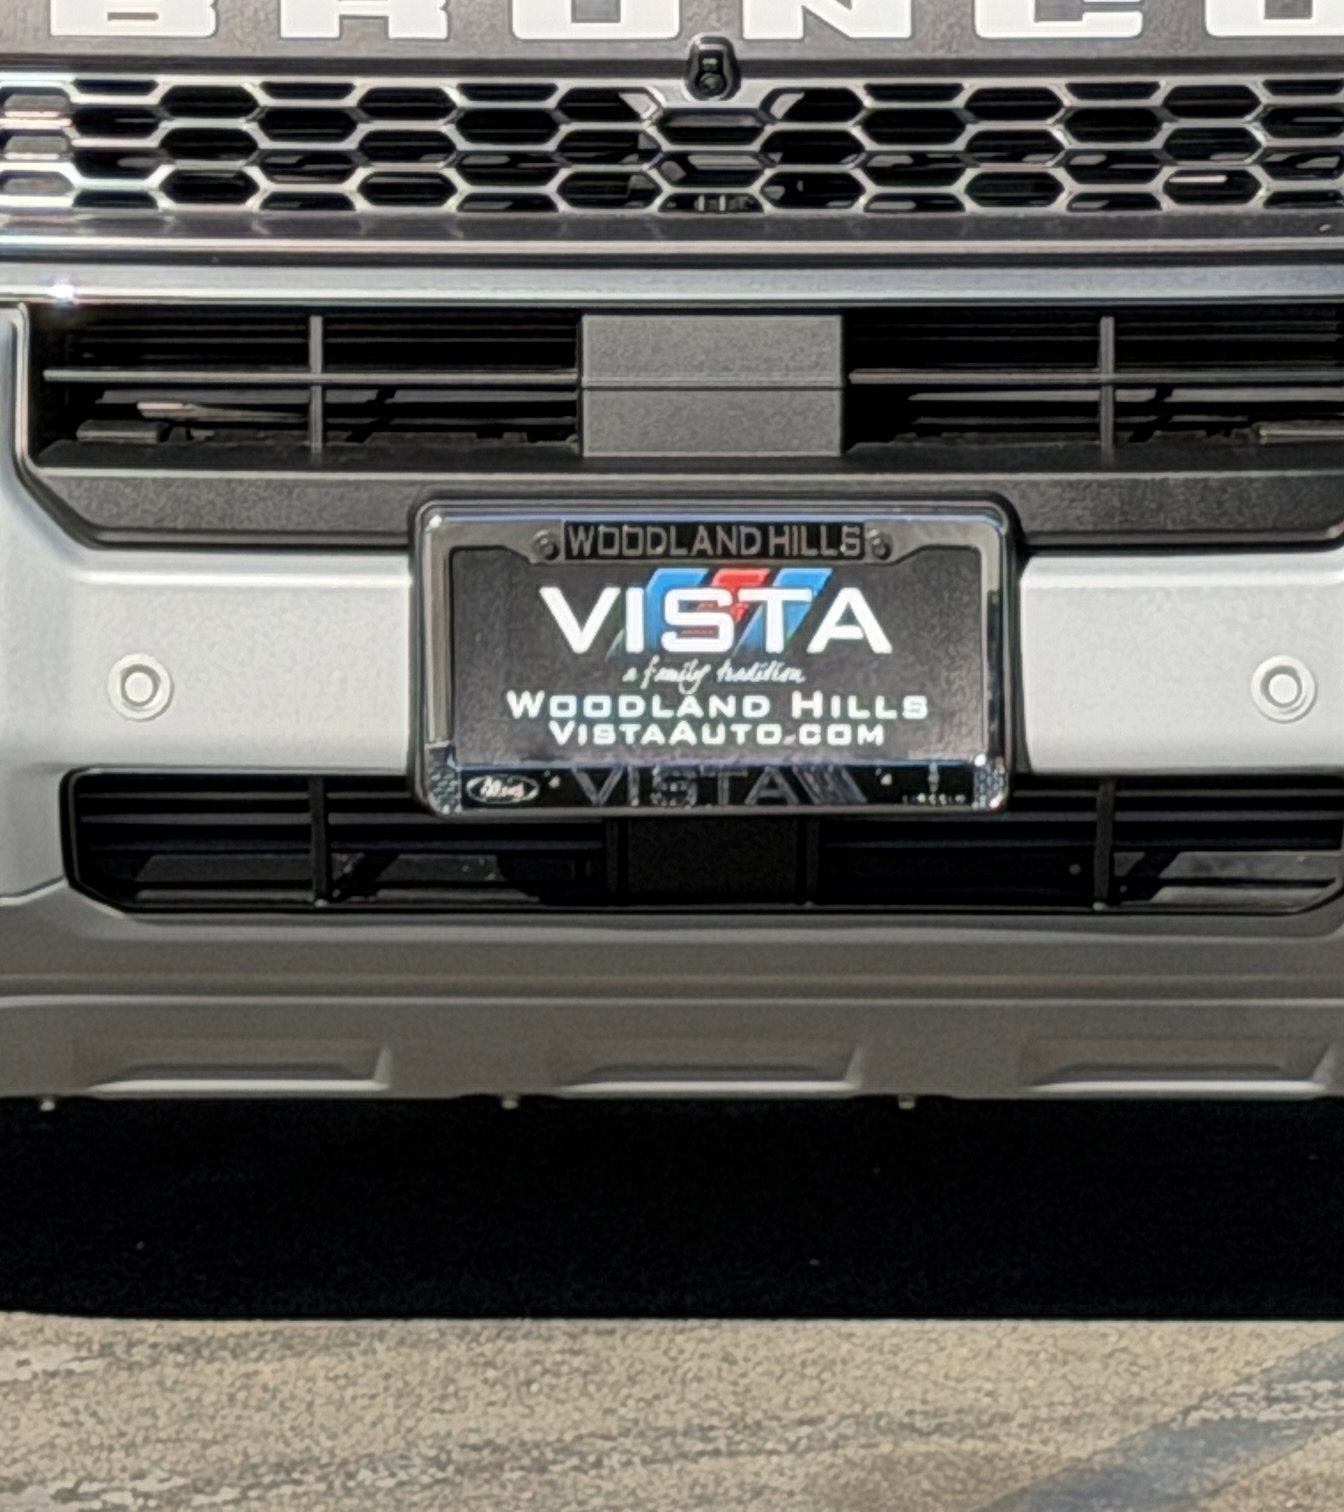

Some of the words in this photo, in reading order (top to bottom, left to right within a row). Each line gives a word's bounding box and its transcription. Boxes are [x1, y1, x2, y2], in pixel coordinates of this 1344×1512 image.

[567, 524, 763, 557] WOODLAND
[768, 524, 863, 557] HILLS
[539, 586, 893, 655] VISTA
[506, 689, 771, 720] WOODLAND
[791, 689, 929, 720] HILLS
